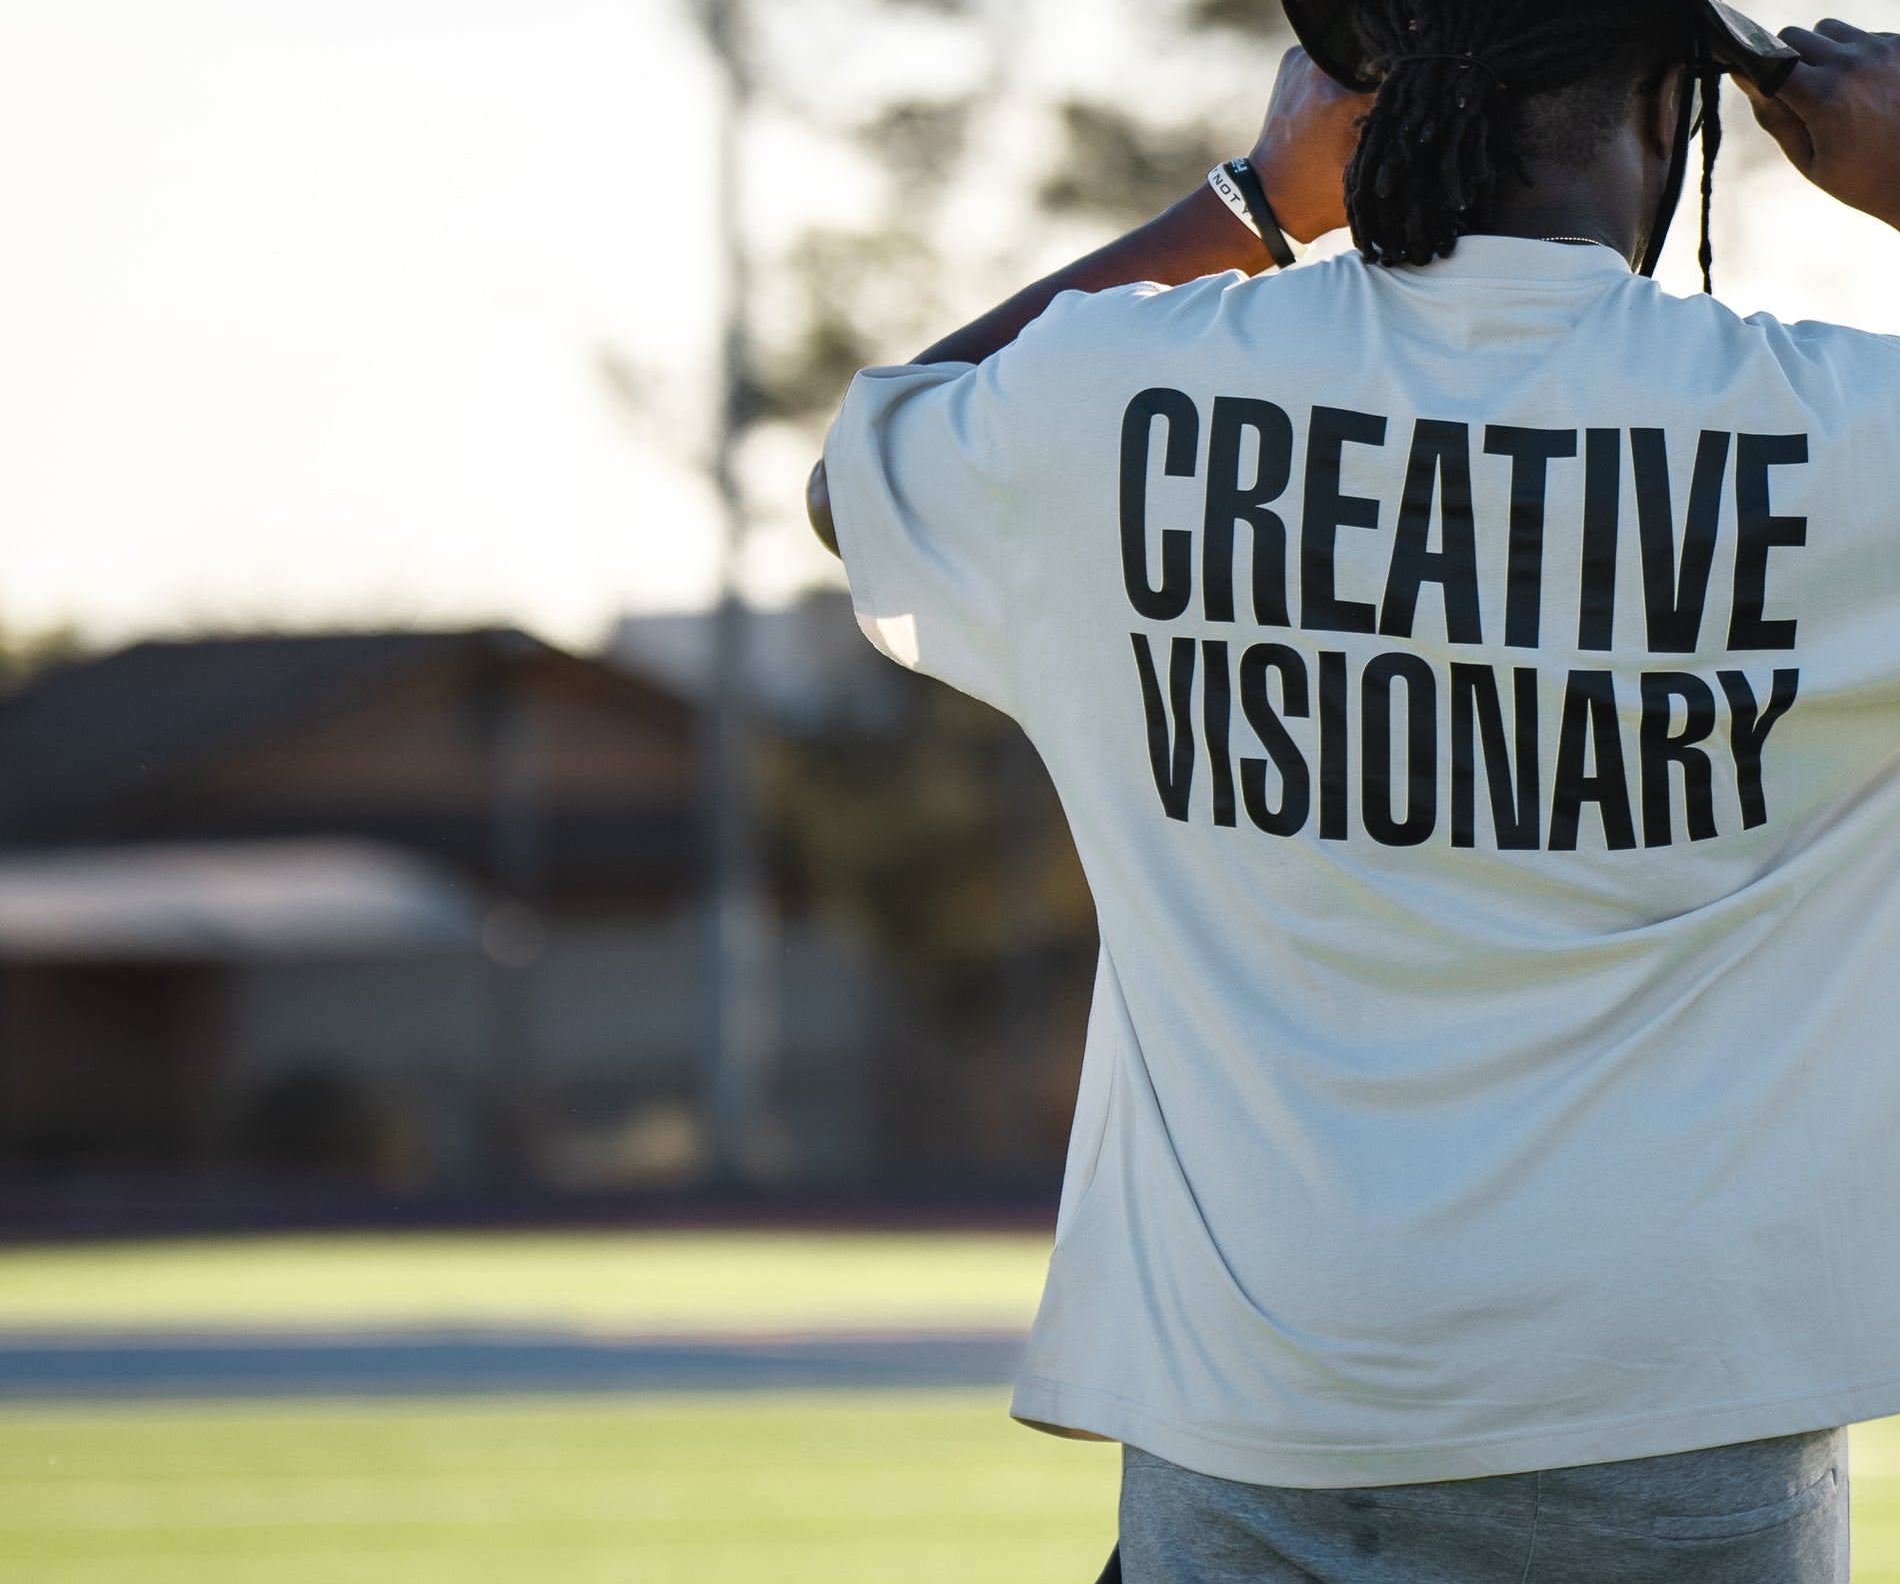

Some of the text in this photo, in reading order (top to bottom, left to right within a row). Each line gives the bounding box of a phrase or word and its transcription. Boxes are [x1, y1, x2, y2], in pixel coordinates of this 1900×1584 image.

[1213, 174, 1241, 202] NOT
[1119, 387, 1809, 654] CREATIVE
[1129, 632, 1800, 852] VISIONARY
